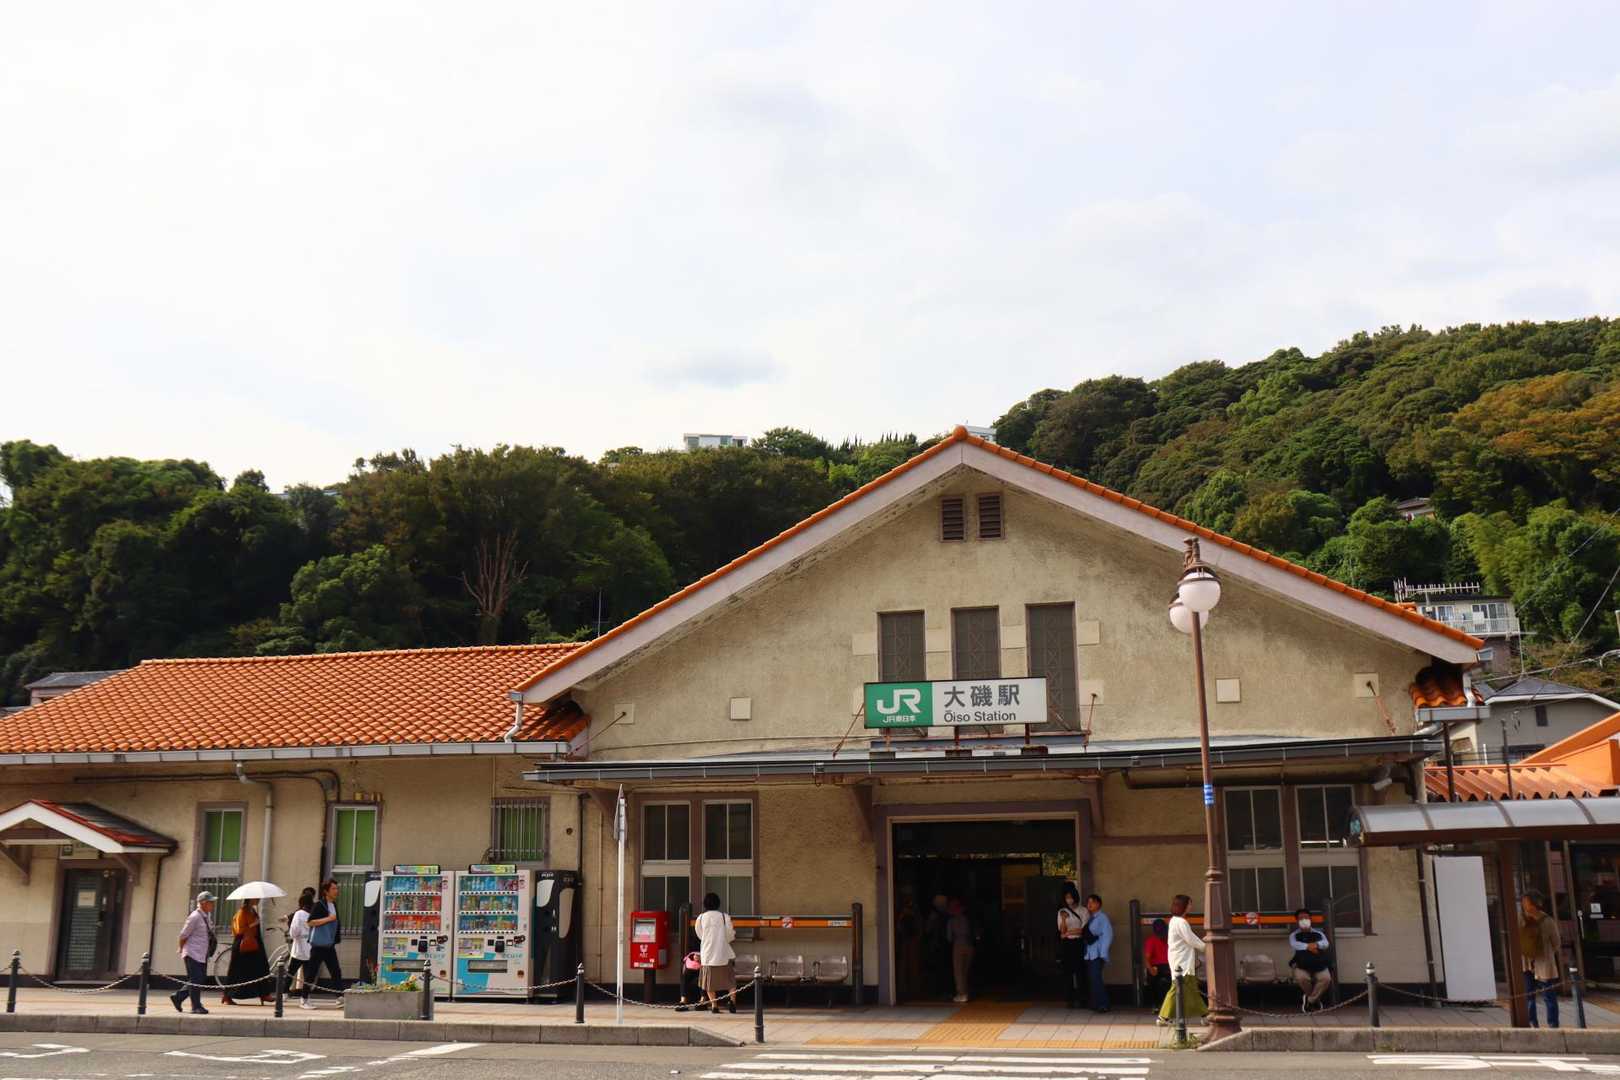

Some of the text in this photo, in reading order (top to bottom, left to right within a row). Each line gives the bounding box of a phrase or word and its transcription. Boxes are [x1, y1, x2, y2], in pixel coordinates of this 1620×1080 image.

[876, 688, 921, 714] JR
[943, 684, 1020, 708] 大磯駅
[974, 710, 1017, 722] Station
